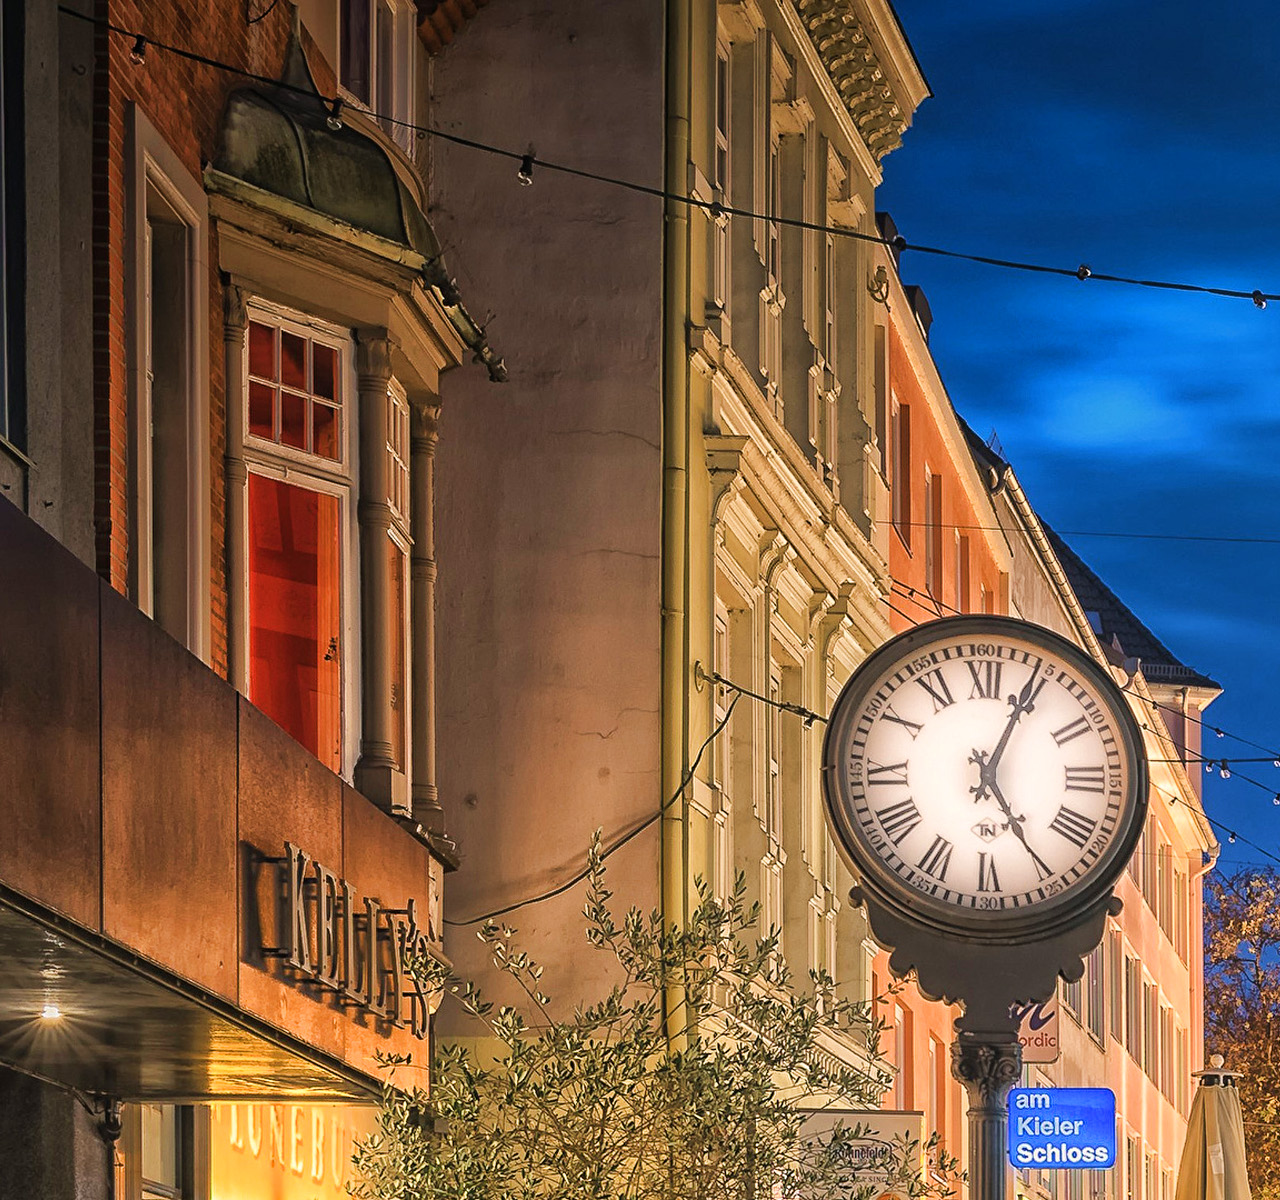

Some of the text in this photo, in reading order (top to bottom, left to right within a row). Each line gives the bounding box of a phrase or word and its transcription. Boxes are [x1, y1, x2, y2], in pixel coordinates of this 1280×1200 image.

[976, 643, 995, 656] 60
[911, 653, 932, 673] 55
[1045, 663, 1056, 677] 5
[964, 660, 1004, 700] XII
[913, 666, 957, 715] XI
[869, 699, 884, 719] 50
[1088, 706, 1105, 725] 10
[879, 703, 925, 741] X
[1049, 714, 1094, 748] II
[849, 762, 862, 782] 45
[1064, 764, 1106, 795] III
[1108, 772, 1122, 789] 15
[863, 824, 882, 847] 40
[1091, 834, 1110, 853] 20
[912, 874, 933, 893] 35
[1044, 879, 1064, 896] 25
[979, 896, 998, 910] 30
[1016, 1093, 1050, 1109] am
[1017, 1116, 1084, 1136] Kieler
[1016, 1143, 1109, 1164] Schloss
